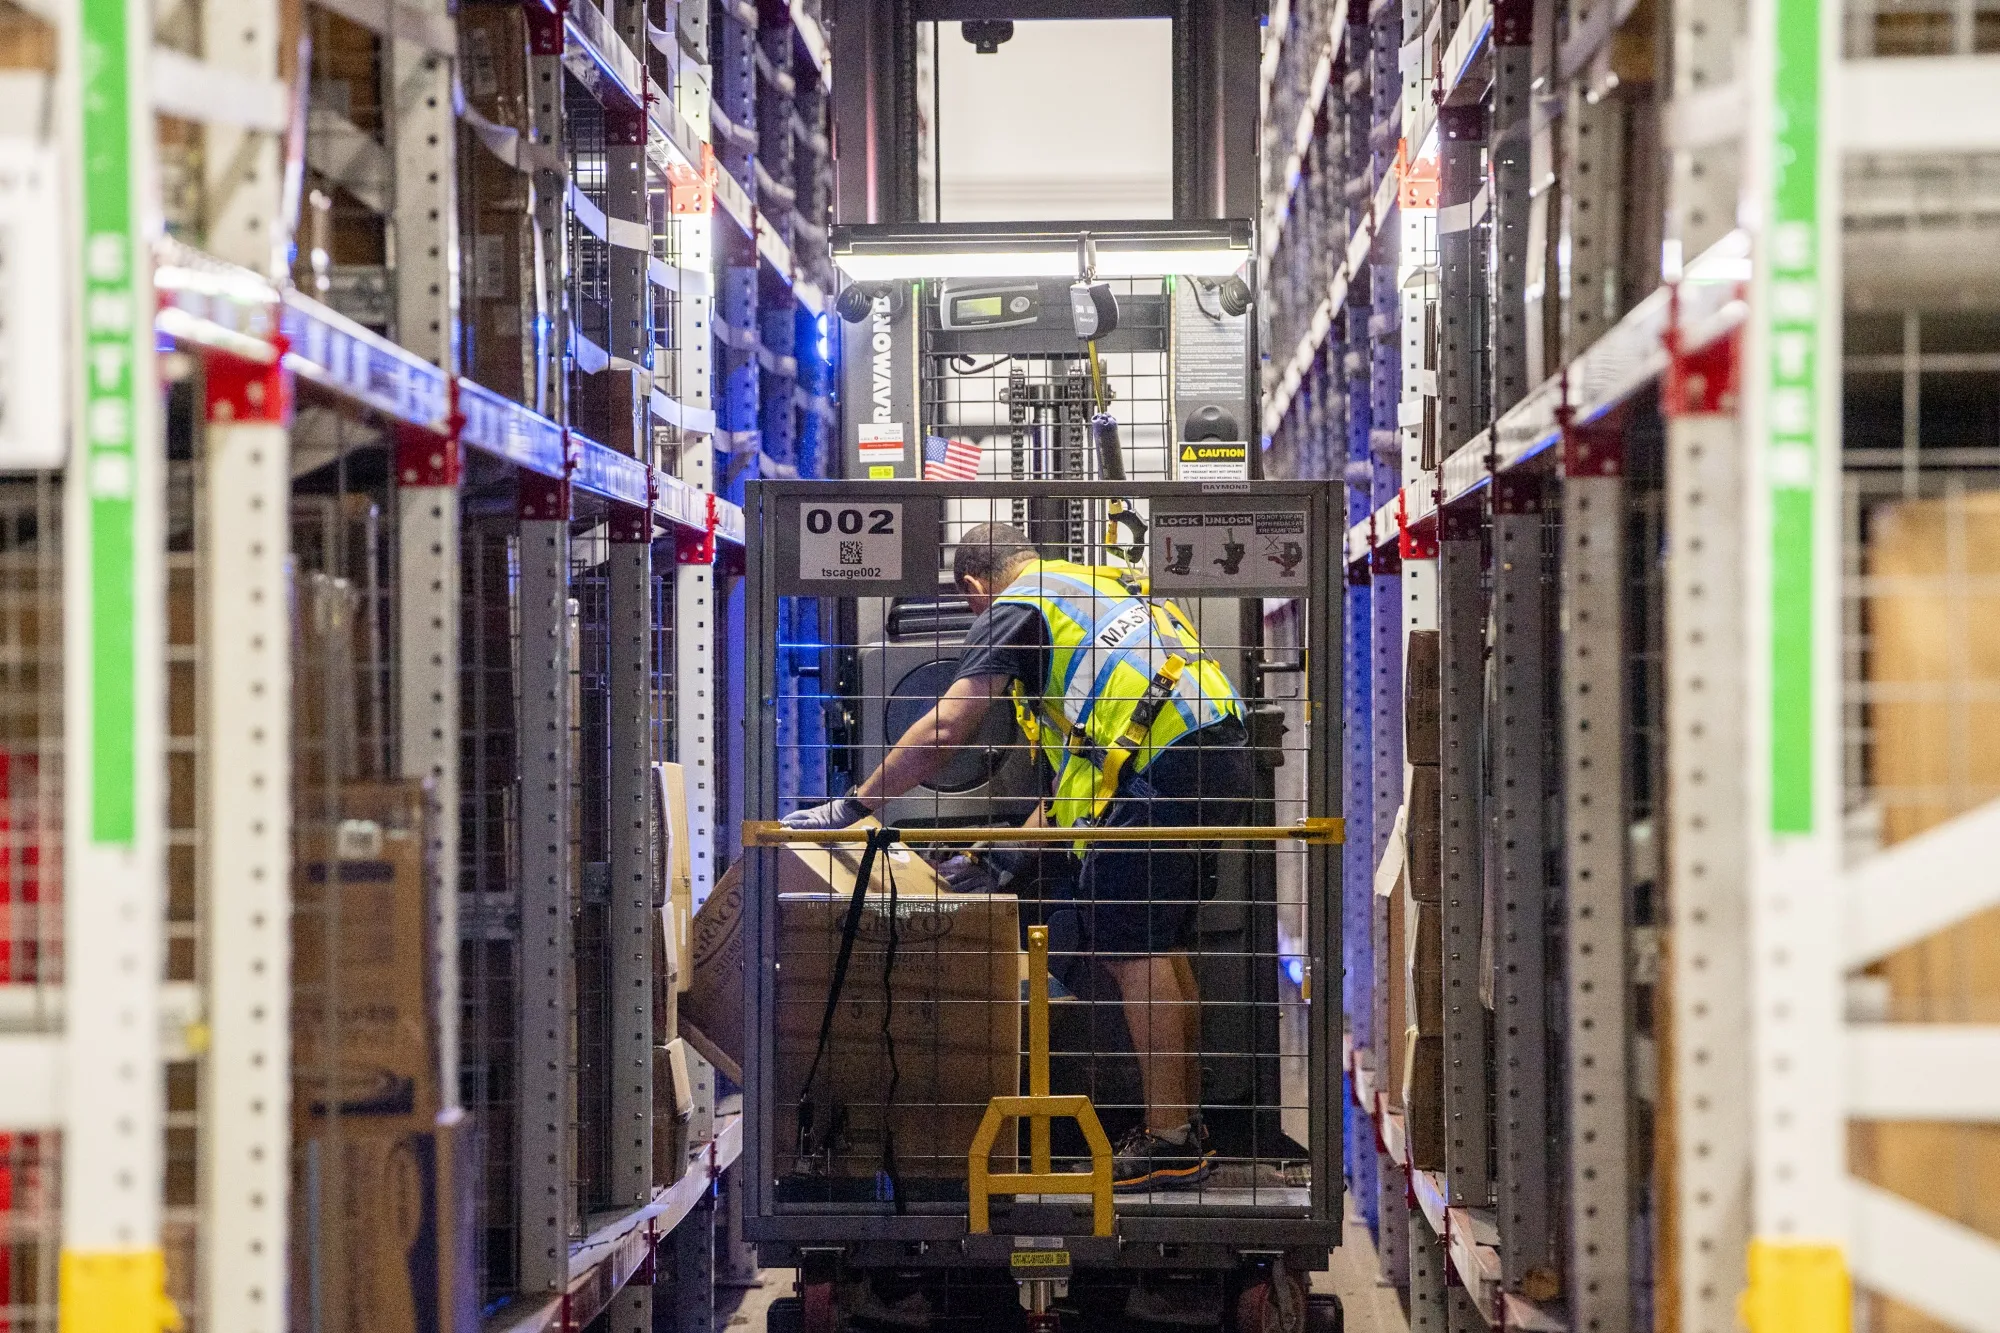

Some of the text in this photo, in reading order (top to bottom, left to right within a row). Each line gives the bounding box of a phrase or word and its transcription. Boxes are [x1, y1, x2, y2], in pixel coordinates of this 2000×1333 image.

[872, 295, 892, 424] RAYMOND
[1198, 448, 1245, 458] CAUTION
[806, 508, 894, 535] 002
[1159, 517, 1199, 525] LOCK
[1205, 516, 1253, 525] UNLOCK
[822, 567, 882, 579] tscage002
